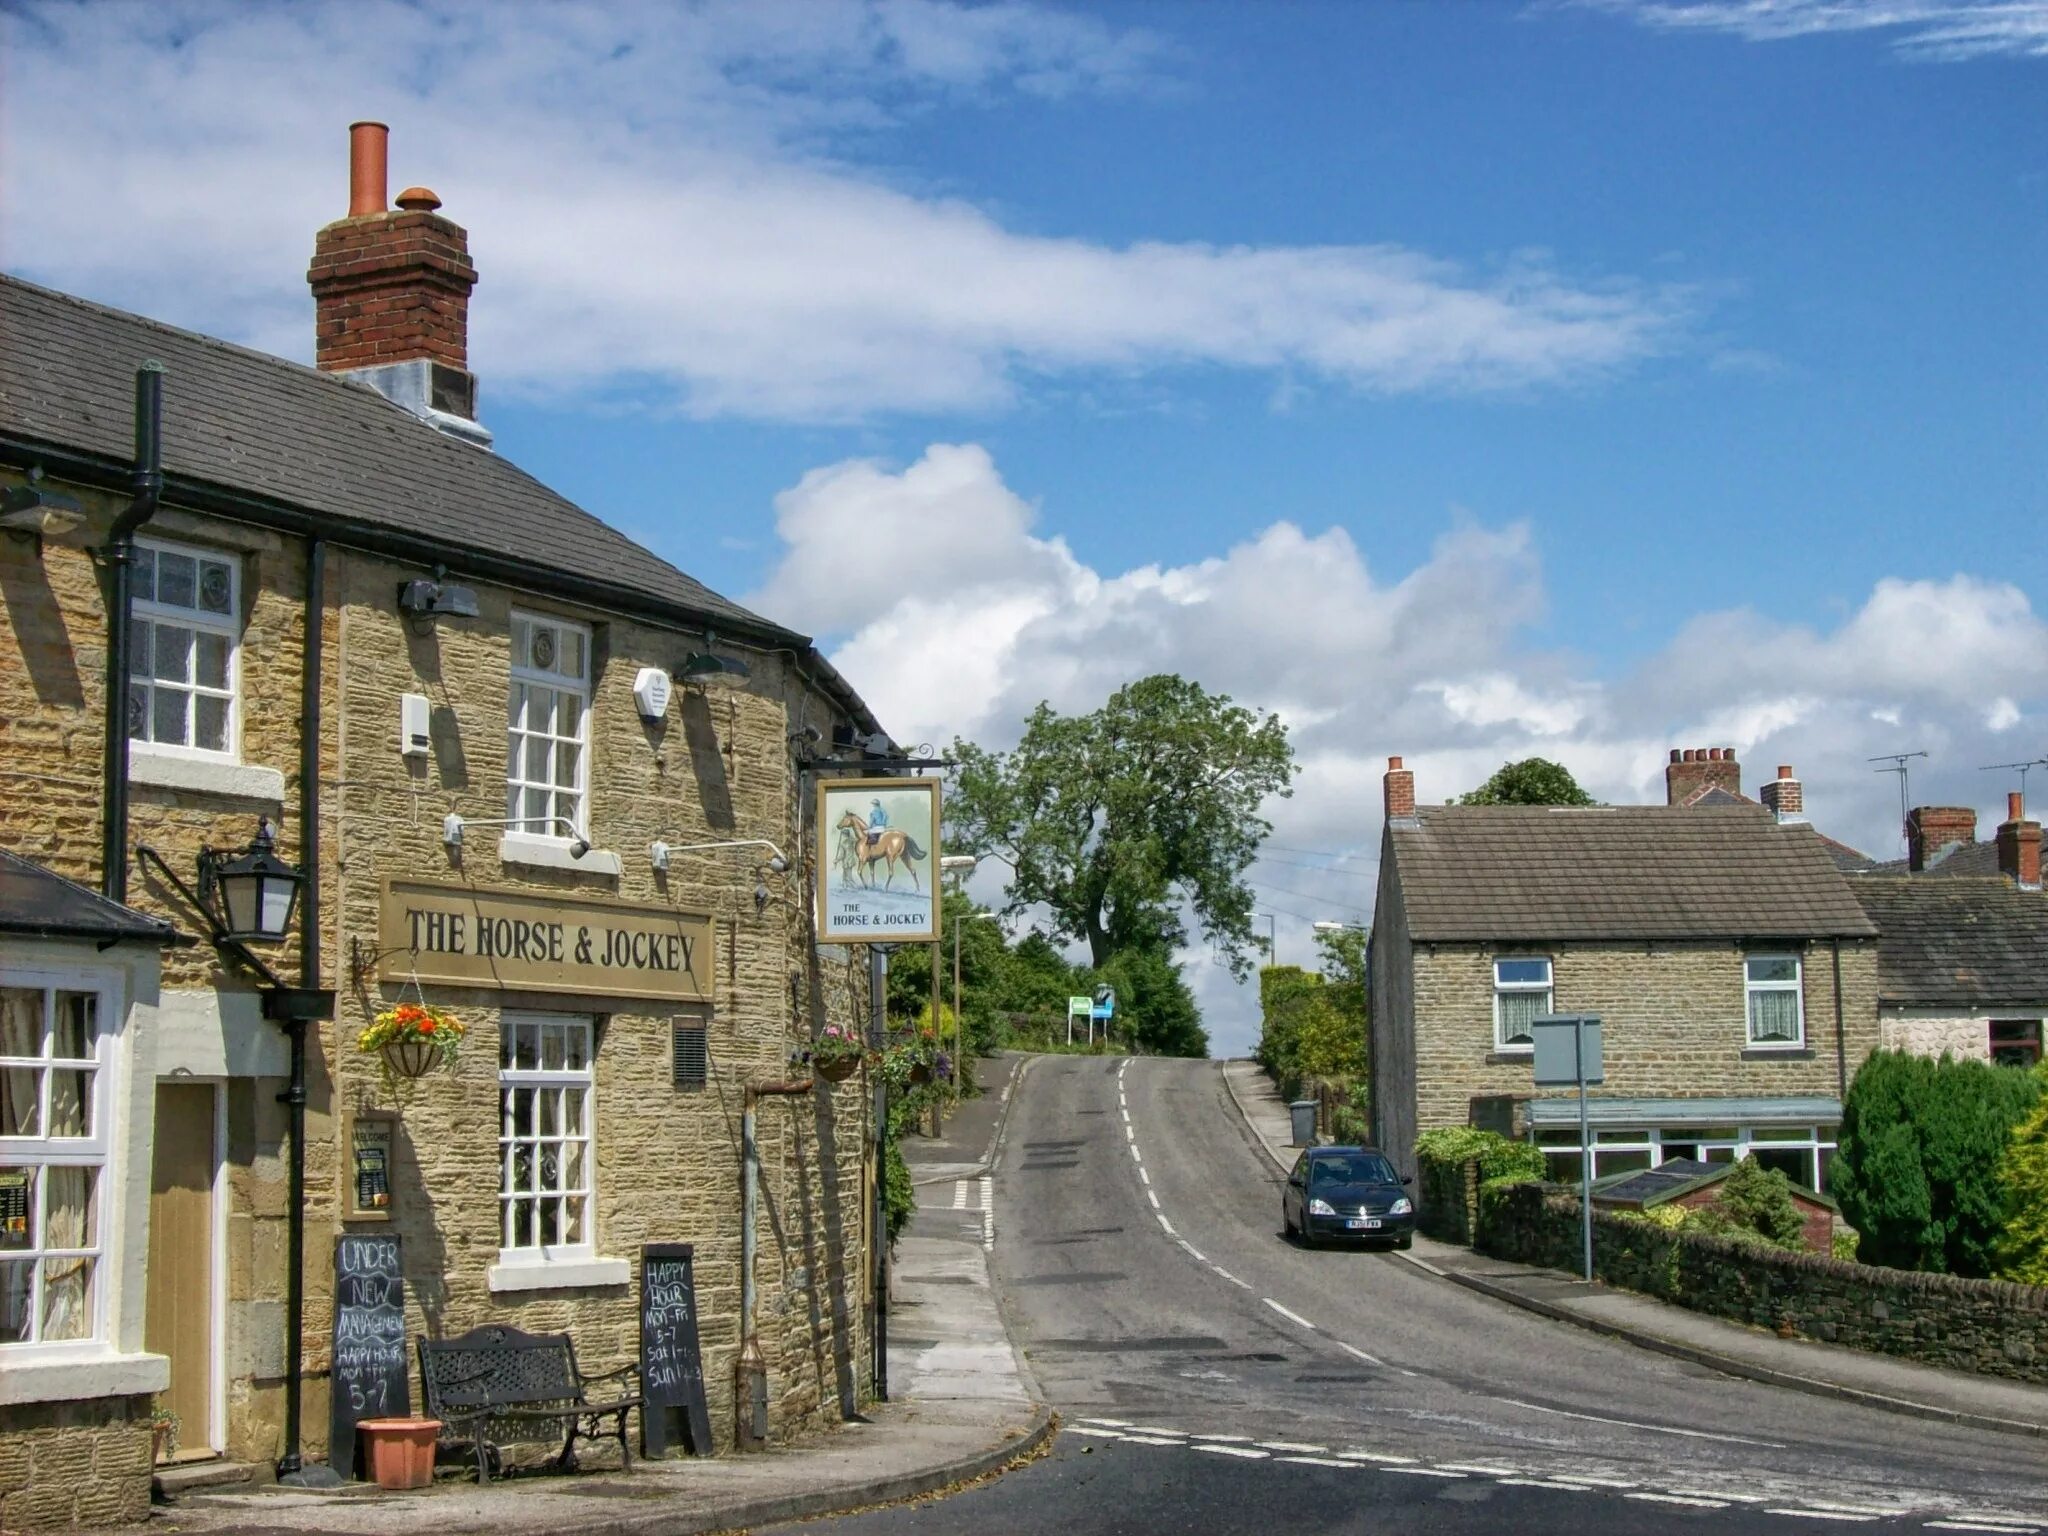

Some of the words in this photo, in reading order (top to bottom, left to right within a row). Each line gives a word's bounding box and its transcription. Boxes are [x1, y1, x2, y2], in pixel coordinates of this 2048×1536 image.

[843, 903, 861, 912] THE
[833, 914, 869, 926] HORSE
[872, 914, 881, 925] &
[883, 913, 927, 925] JOCKEY
[405, 906, 466, 954] THE
[476, 916, 564, 964] HORSE
[574, 926, 594, 965] &
[600, 929, 696, 972] JOCKEY
[342, 1240, 399, 1272] UNDER
[646, 1262, 686, 1288] HAPPY
[352, 1278, 392, 1306] NEW
[650, 1286, 683, 1306] HOUR
[656, 1327, 677, 1344] 5-7
[647, 1346, 670, 1363] Sat
[648, 1365, 675, 1388] Sun
